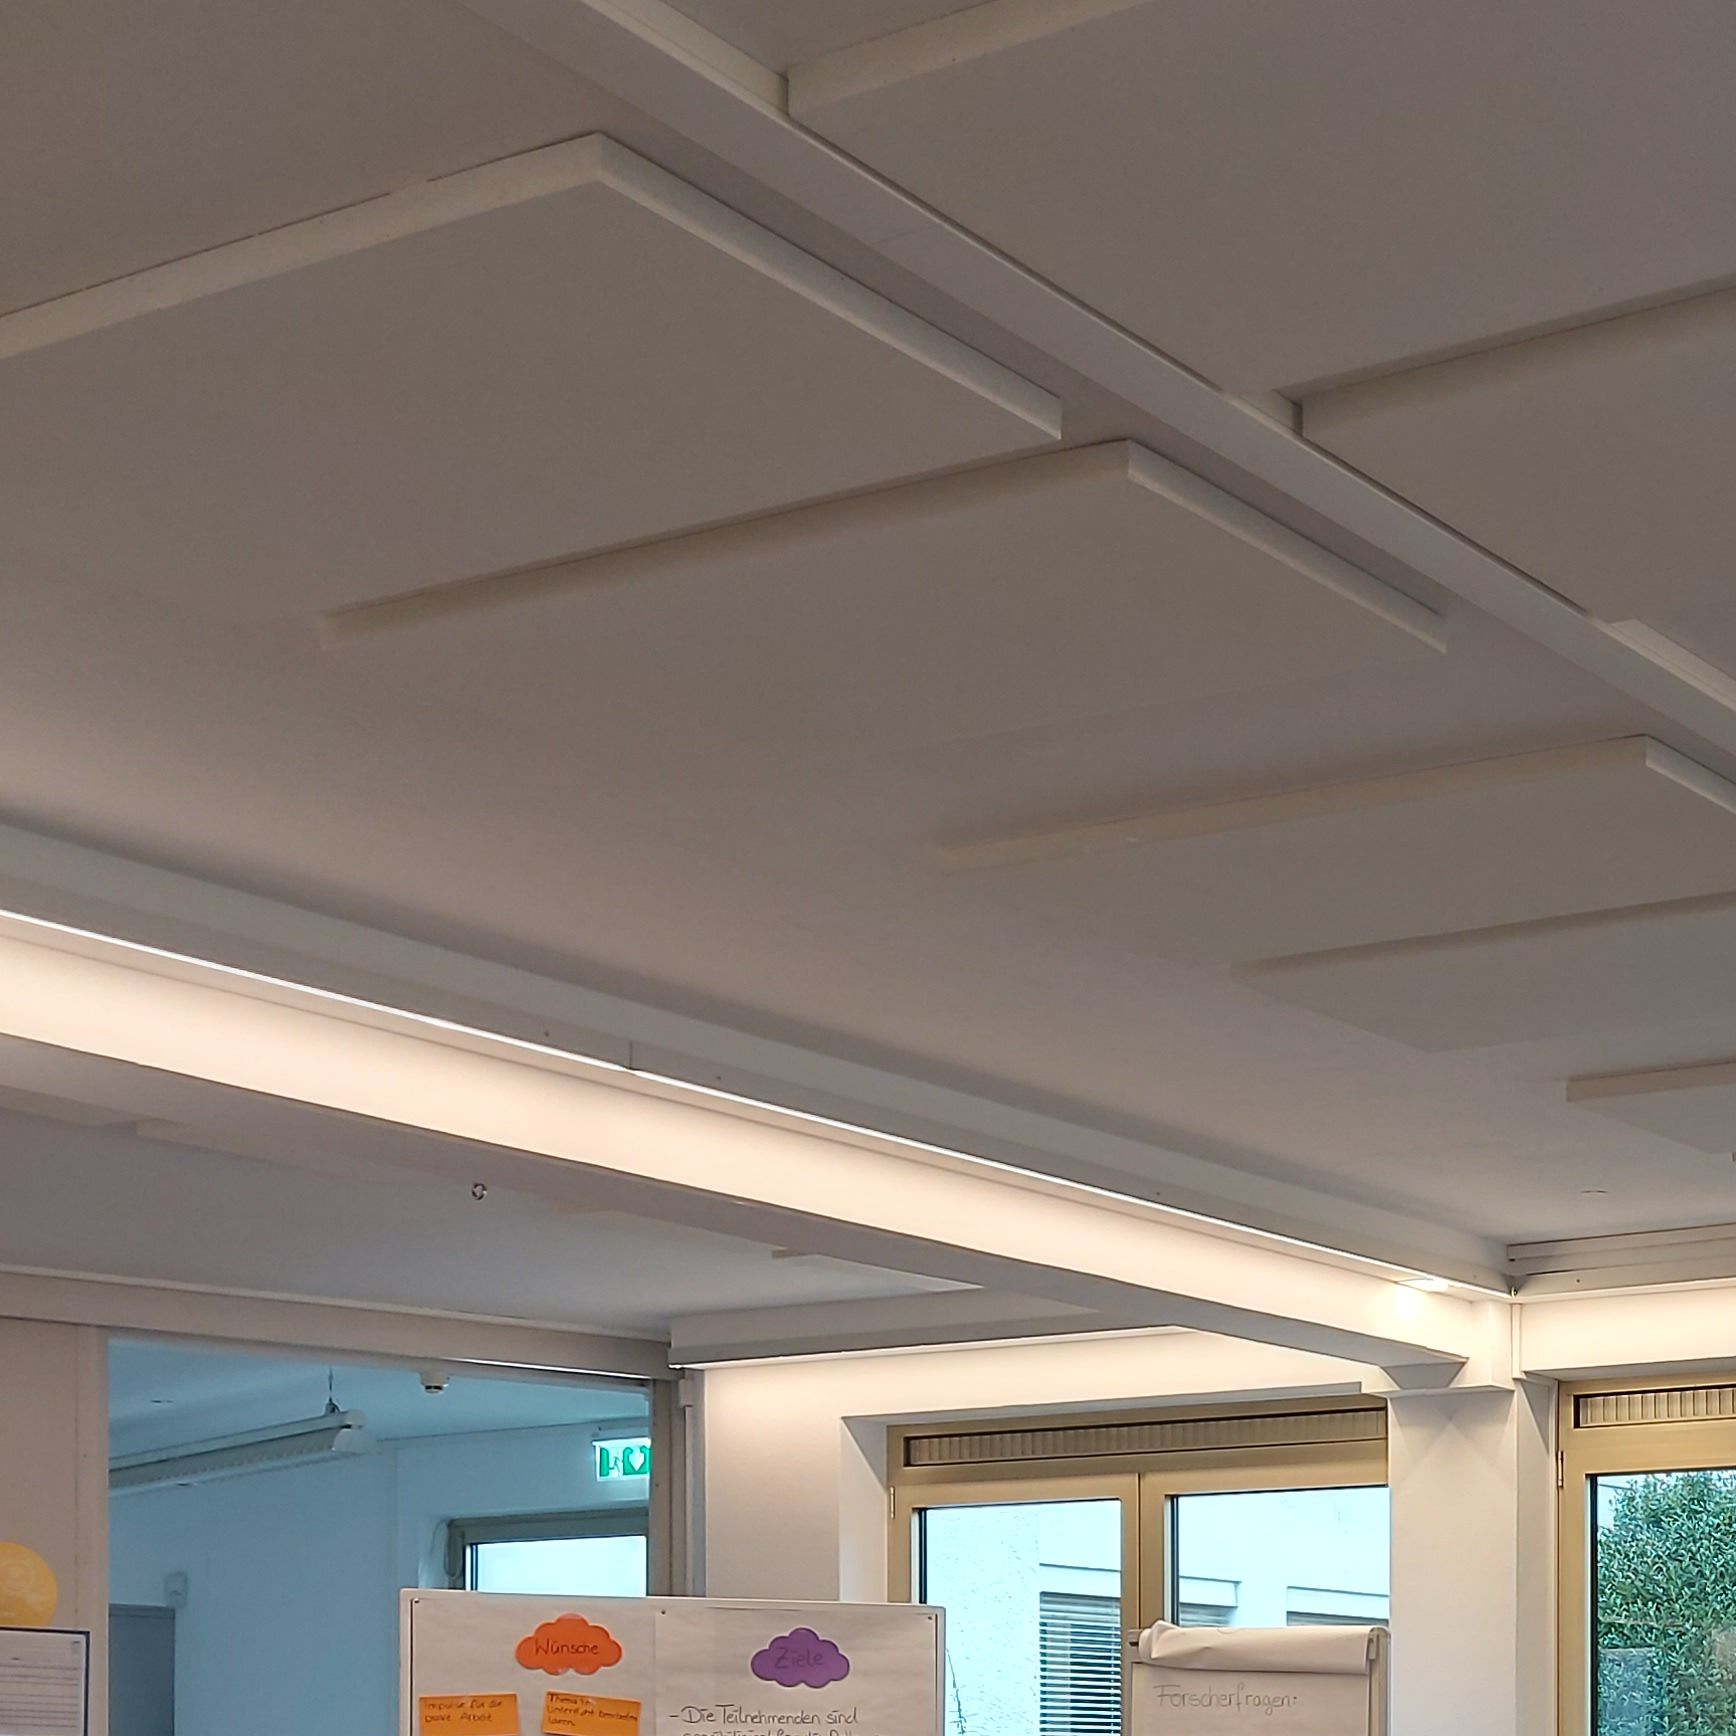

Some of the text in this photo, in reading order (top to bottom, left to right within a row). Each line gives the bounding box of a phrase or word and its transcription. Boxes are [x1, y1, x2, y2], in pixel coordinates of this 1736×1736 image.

[774, 1646, 825, 1669] Ziele
[1152, 1681, 1297, 1716] Forscherfragen:
[681, 1704, 859, 1726] Die Teilnehmenden sind
